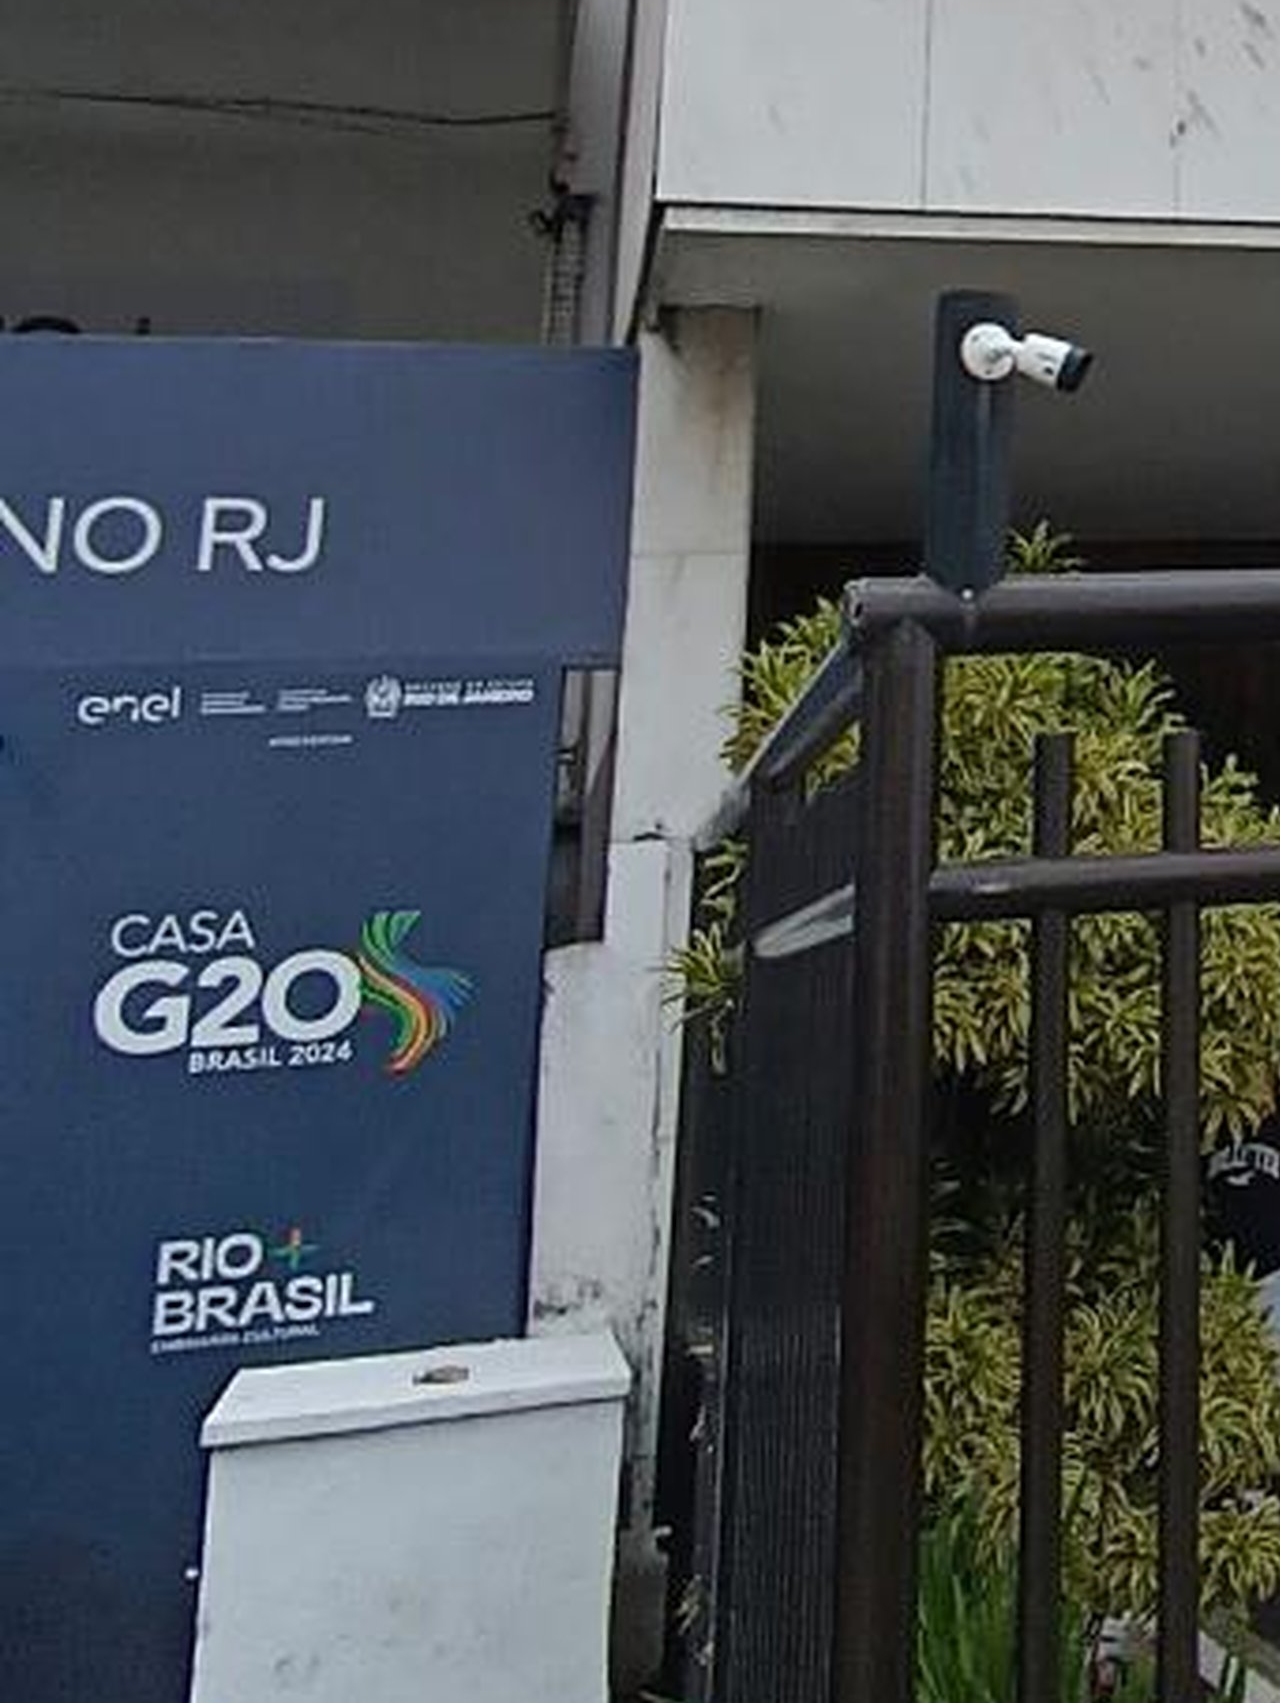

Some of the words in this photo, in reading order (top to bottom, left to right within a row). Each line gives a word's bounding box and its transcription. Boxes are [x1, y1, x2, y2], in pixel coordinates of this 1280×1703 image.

[196, 497, 325, 573] RJ
[77, 686, 182, 725] enel
[111, 910, 256, 958] CASA
[94, 949, 362, 1055] G20
[188, 1047, 283, 1075] BRASIL
[287, 1040, 353, 1067] 2024
[156, 1233, 264, 1286] RIO
[152, 1273, 375, 1336] BRASIL
